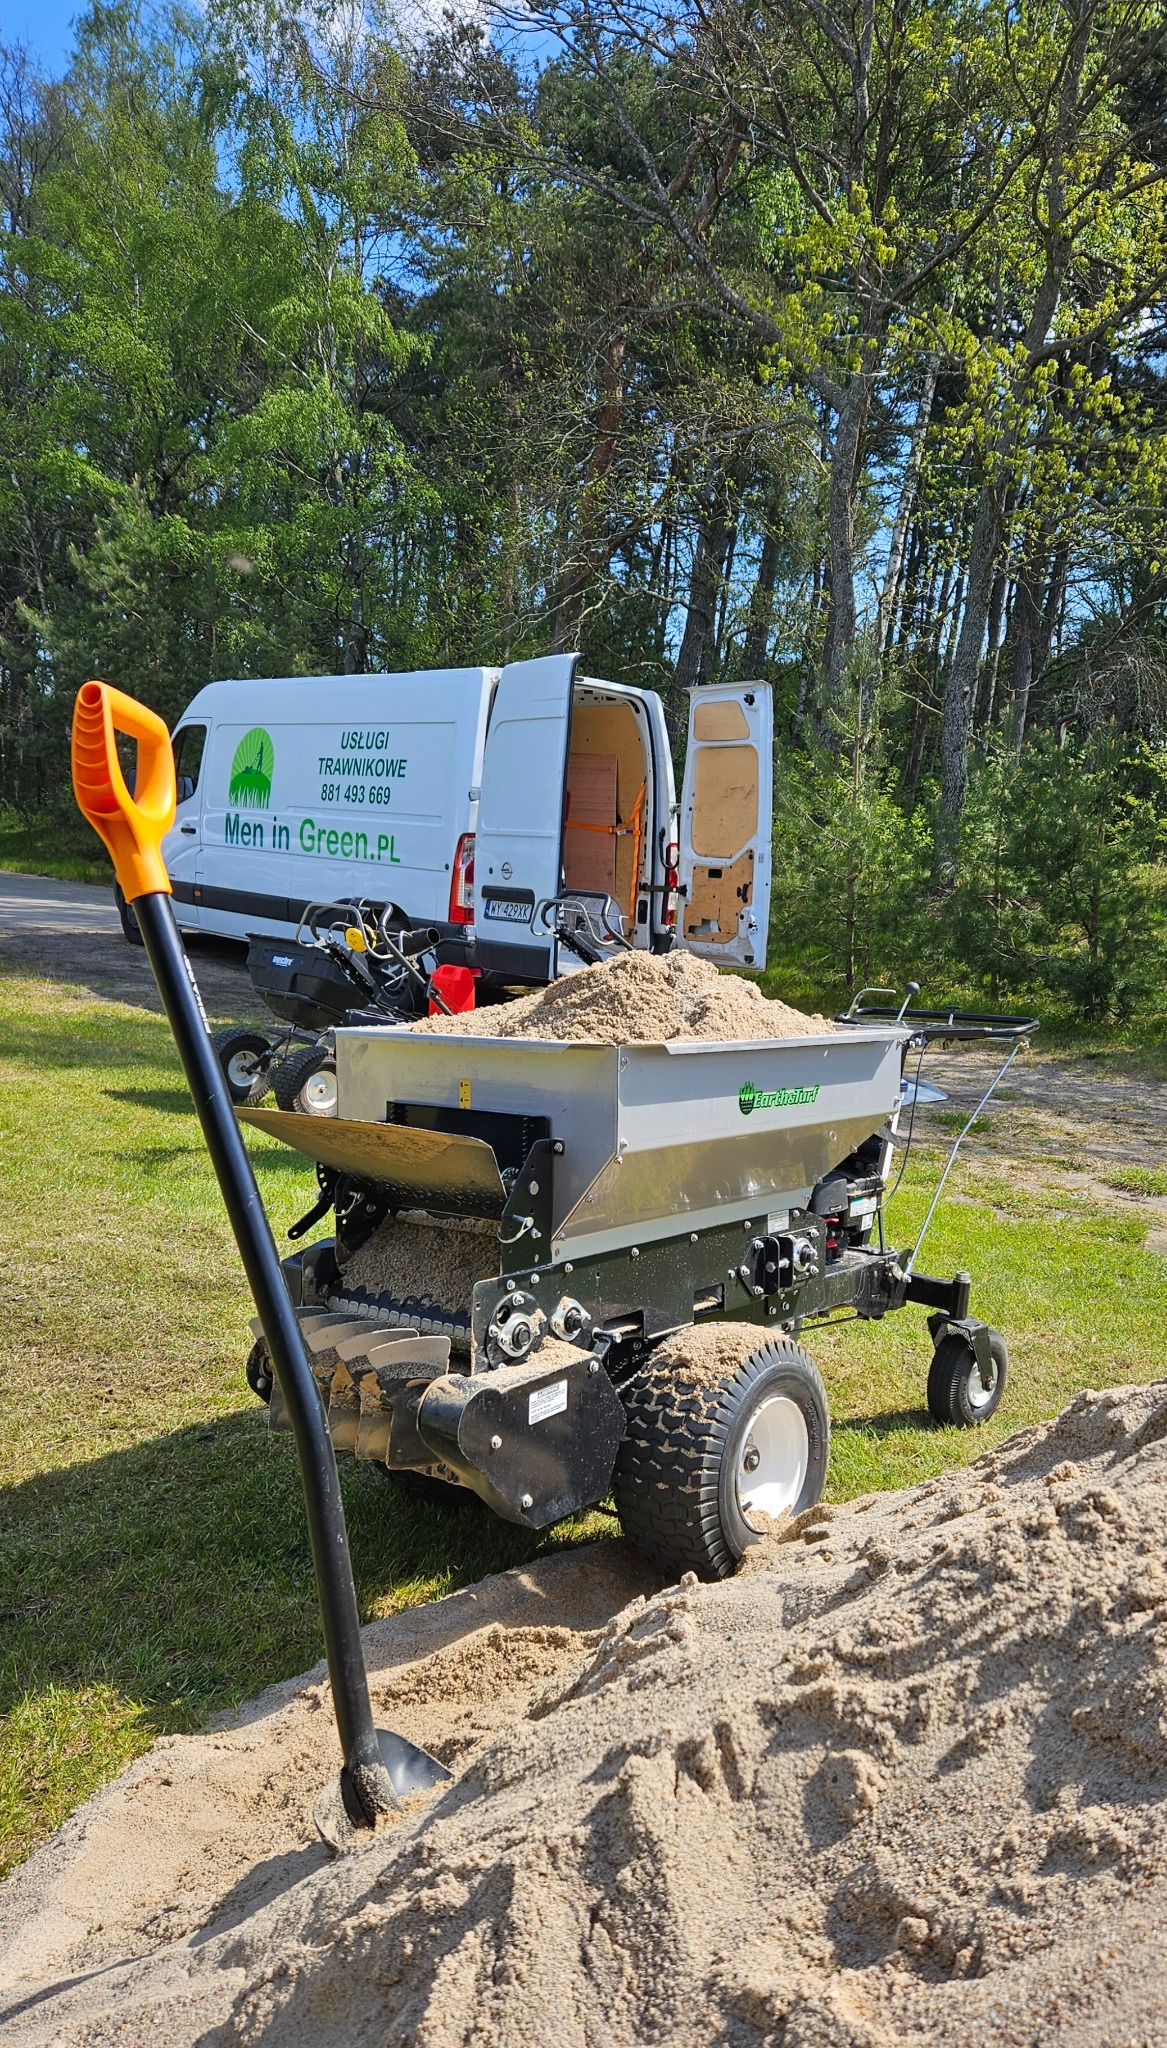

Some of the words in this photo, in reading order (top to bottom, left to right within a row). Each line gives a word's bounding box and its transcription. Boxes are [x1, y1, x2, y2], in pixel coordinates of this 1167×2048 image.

[340, 731, 390, 750] USŁUGI
[318, 757, 407, 778] TRAWNIKOWE
[320, 783, 341, 802] 881
[343, 784, 366, 804] 493
[368, 786, 391, 805] 669
[224, 812, 264, 848] Men
[272, 815, 290, 851] in
[299, 818, 401, 863] Green.PL
[490, 901, 502, 916] WY
[503, 903, 530, 919] 429XK
[753, 1084, 820, 1109] Earth&Turf
